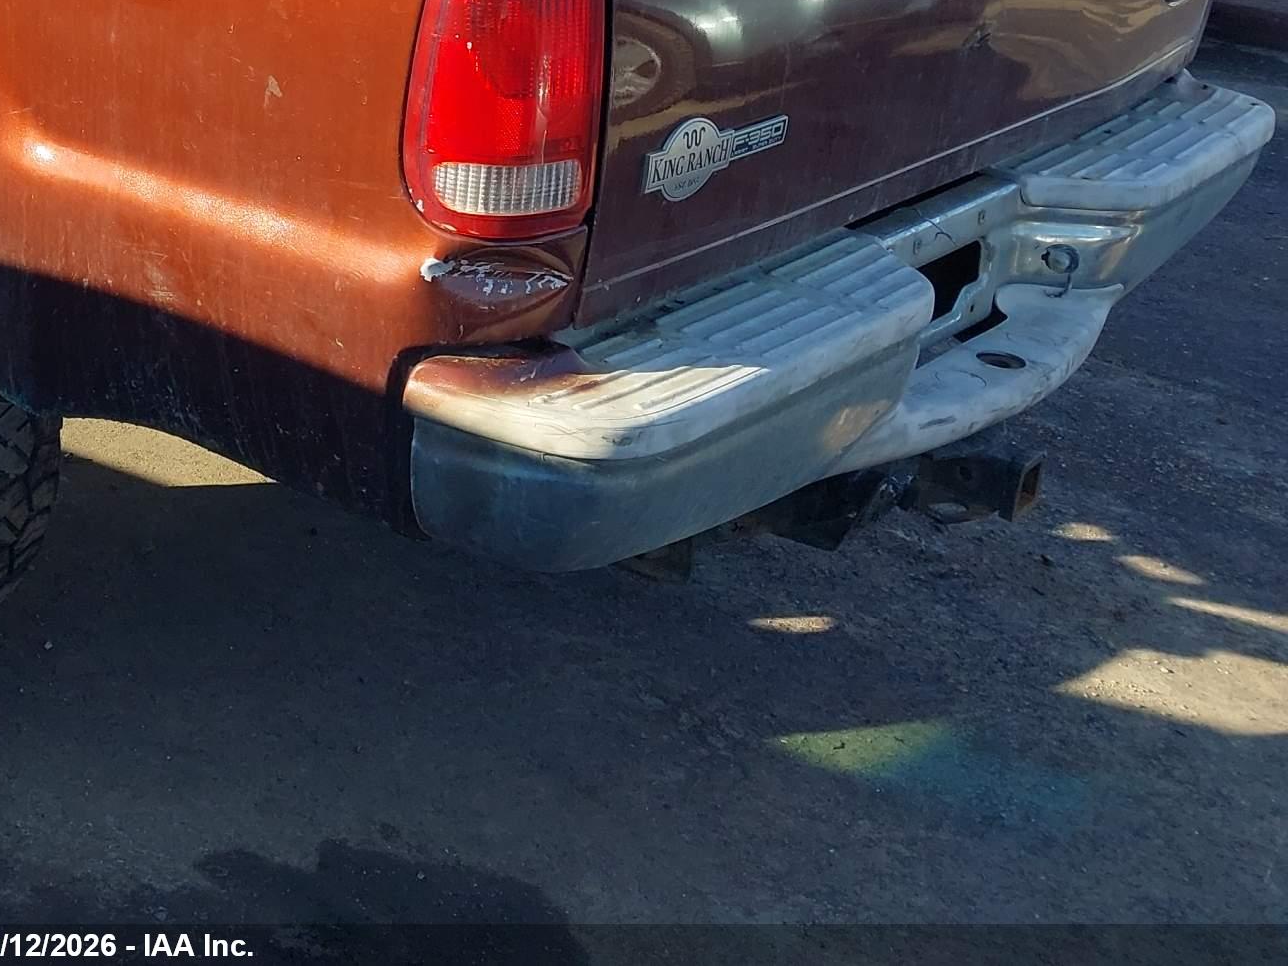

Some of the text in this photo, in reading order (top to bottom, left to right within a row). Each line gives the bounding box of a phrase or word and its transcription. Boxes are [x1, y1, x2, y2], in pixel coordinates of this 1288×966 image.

[733, 122, 785, 151] F-350
[651, 158, 685, 184] KING
[686, 137, 731, 173] RANCH
